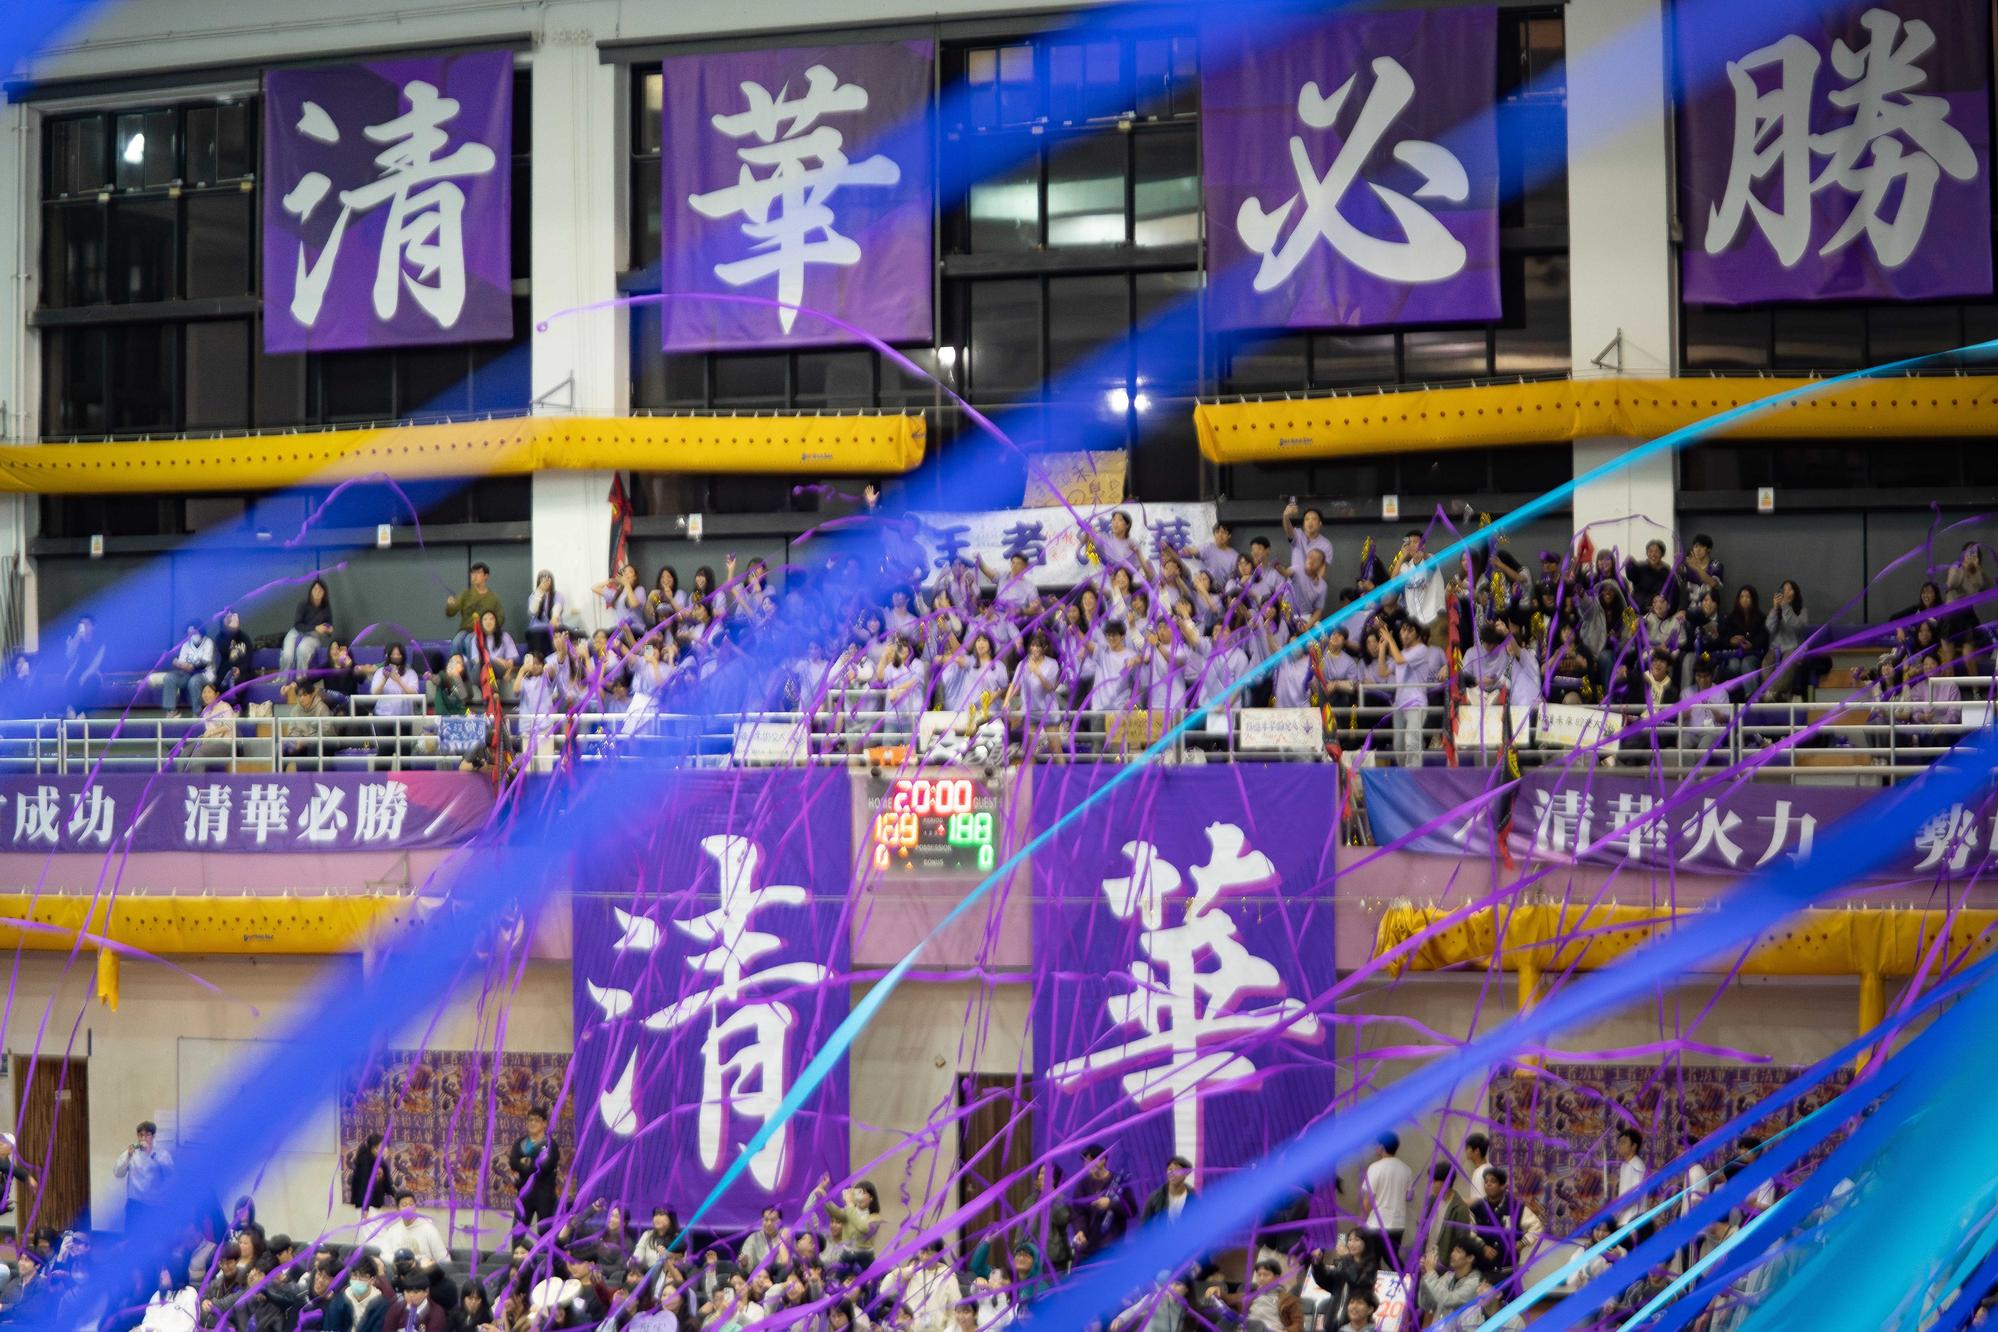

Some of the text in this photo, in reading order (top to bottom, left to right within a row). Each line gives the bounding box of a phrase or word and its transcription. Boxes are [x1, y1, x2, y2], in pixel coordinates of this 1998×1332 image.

[284, 81, 495, 327] 清
[689, 65, 900, 335] 華
[1237, 57, 1470, 292] 必
[1705, 9, 1978, 268] 勝
[0, 780, 408, 845] 成功 清華必勝
[893, 779, 973, 813] 20:00
[978, 844, 993, 867] 0
[1534, 788, 1998, 872] 清華火力 勢
[587, 834, 833, 1193] 清
[1046, 822, 1320, 1190] 華
